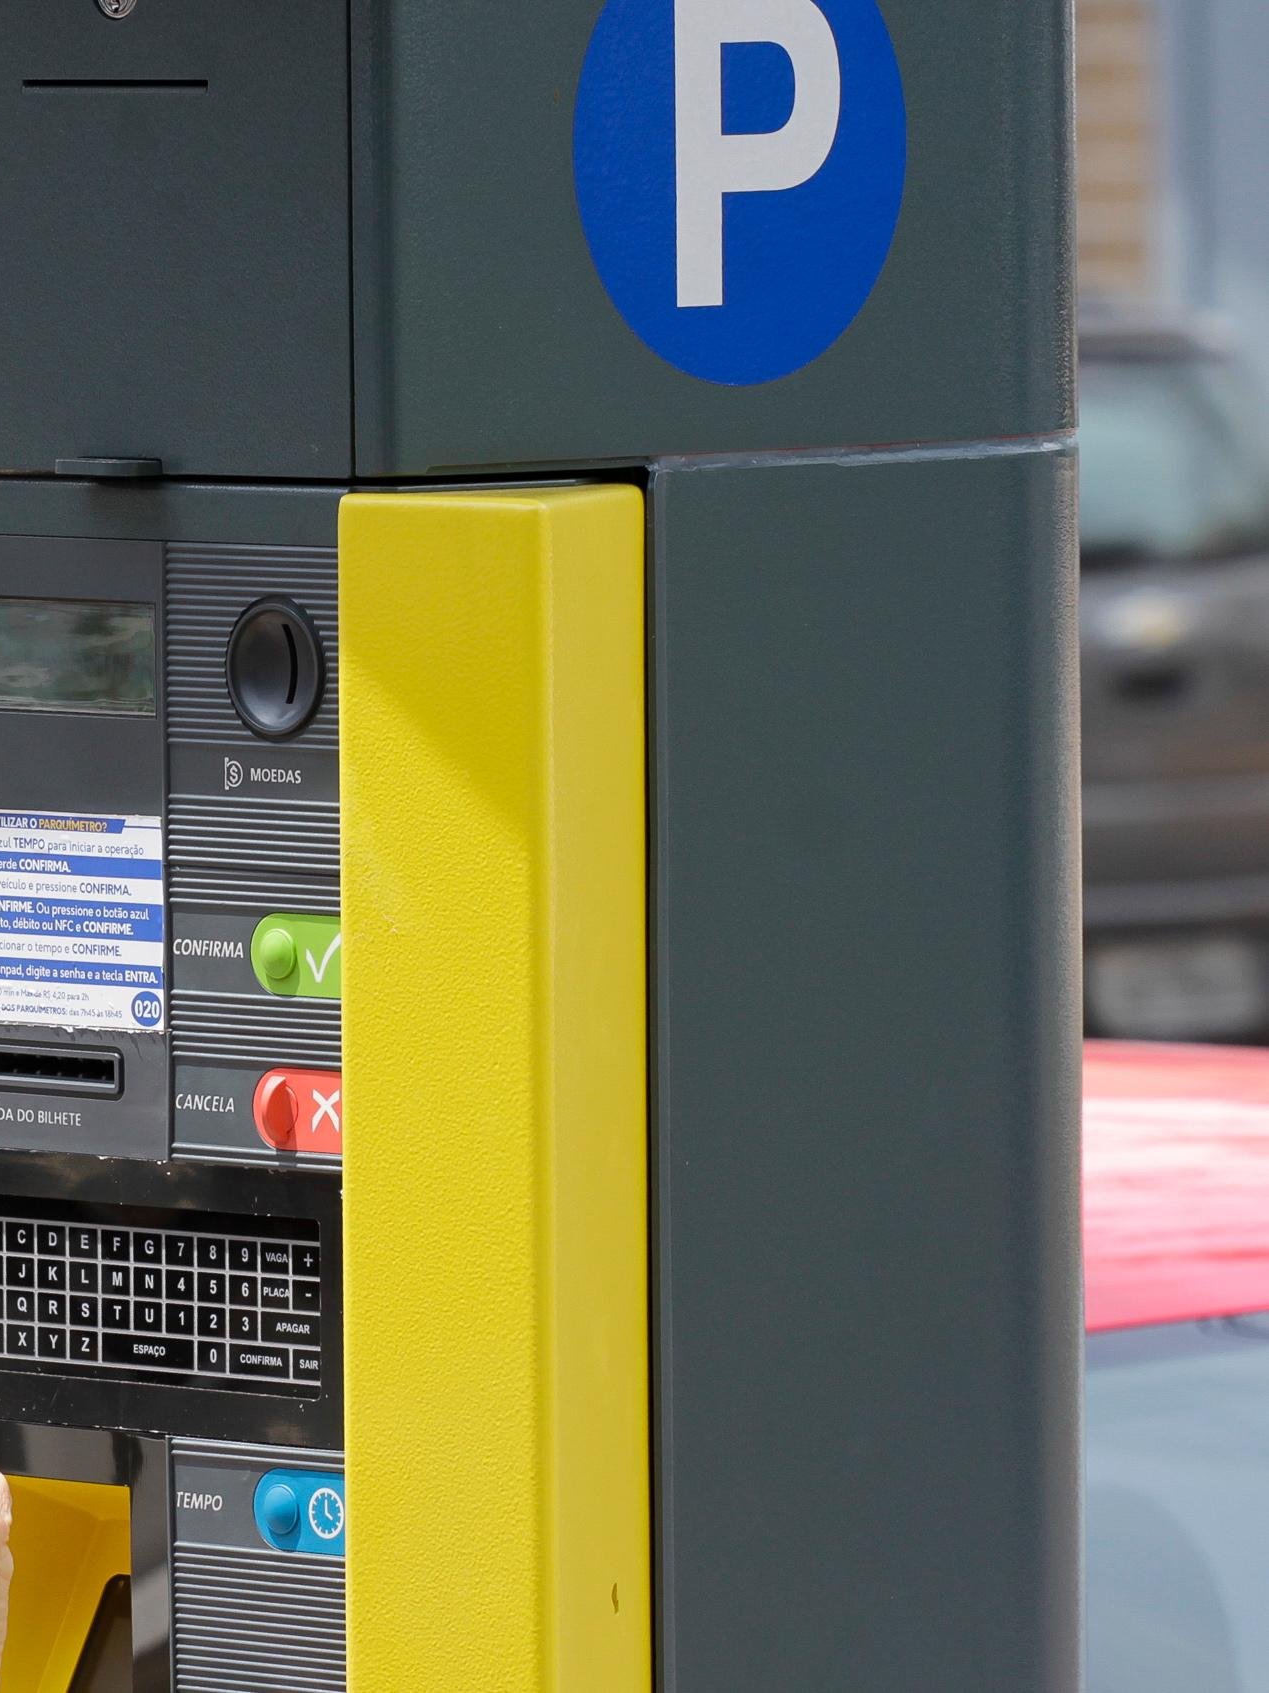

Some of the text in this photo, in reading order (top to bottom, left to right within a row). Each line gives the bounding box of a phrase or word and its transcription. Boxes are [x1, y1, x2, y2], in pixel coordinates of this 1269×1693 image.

[674, 0, 841, 308] P
[250, 767, 301, 784] MOEDAS
[30, 818, 37, 829] O
[38, 817, 108, 833] PARQUÍMETRO?
[13, 837, 45, 850] TEMPO
[48, 842, 67, 854] para
[97, 844, 103, 853] a
[105, 844, 144, 858] operação
[19, 859, 71, 873] CONFIRMA.
[28, 881, 34, 890] e
[35, 881, 77, 895] pressione
[79, 882, 132, 896] CONFIRMA.
[36, 902, 50, 915] Ou
[51, 904, 94, 917] pressione
[95, 908, 102, 917] o
[103, 906, 129, 919] botão
[130, 908, 149, 921] azul
[12, 916, 40, 930] débito
[41, 921, 53, 931] ou
[55, 919, 74, 932] NFC
[75, 923, 82, 932] e
[27, 943, 33, 952] o
[35, 943, 63, 956] tempo
[64, 945, 70, 954] e
[173, 938, 244, 958] CONFIRMA
[26, 964, 50, 980] digite
[52, 968, 58, 978] a
[60, 966, 86, 979] senha
[87, 970, 93, 980] e
[95, 971, 101, 980] a
[102, 969, 123, 981] tecla
[124, 970, 159, 984] ENTRA.
[134, 999, 160, 1018] 020
[175, 1093, 235, 1113] CANCELA
[17, 1108, 35, 1123] DO
[38, 1110, 82, 1127] BILHETE
[17, 1229, 26, 1244] C
[48, 1232, 58, 1247] D
[80, 1234, 90, 1250] E
[113, 1237, 121, 1252] F
[144, 1240, 154, 1255] G
[177, 1242, 185, 1257] 7
[209, 1245, 217, 1260] 8
[241, 1248, 249, 1263] 9
[265, 1252, 288, 1263] VAGA
[18, 1264, 26, 1278] J
[48, 1266, 58, 1281] K
[80, 1269, 90, 1284] L
[112, 1271, 123, 1287] M
[144, 1274, 154, 1290] N
[177, 1277, 186, 1292] 4
[209, 1280, 218, 1295] 5
[241, 1282, 250, 1298] 6
[263, 1287, 290, 1298] PLACA
[16, 1296, 28, 1313] Q
[48, 1300, 58, 1315] R
[81, 1302, 90, 1318] S
[113, 1305, 122, 1321] T
[144, 1308, 154, 1324] U
[178, 1311, 185, 1326] 1
[209, 1314, 218, 1329] 2
[242, 1316, 250, 1332] 3
[275, 1322, 310, 1335] APAGAR
[17, 1331, 28, 1347] X
[48, 1334, 59, 1350] Y
[80, 1337, 90, 1353] Z
[132, 1344, 166, 1358] ESPAÇO
[209, 1348, 218, 1364] 0
[239, 1353, 283, 1367] CONFIRMA
[299, 1358, 319, 1371] SAIR
[176, 1491, 223, 1511] TEMPO
